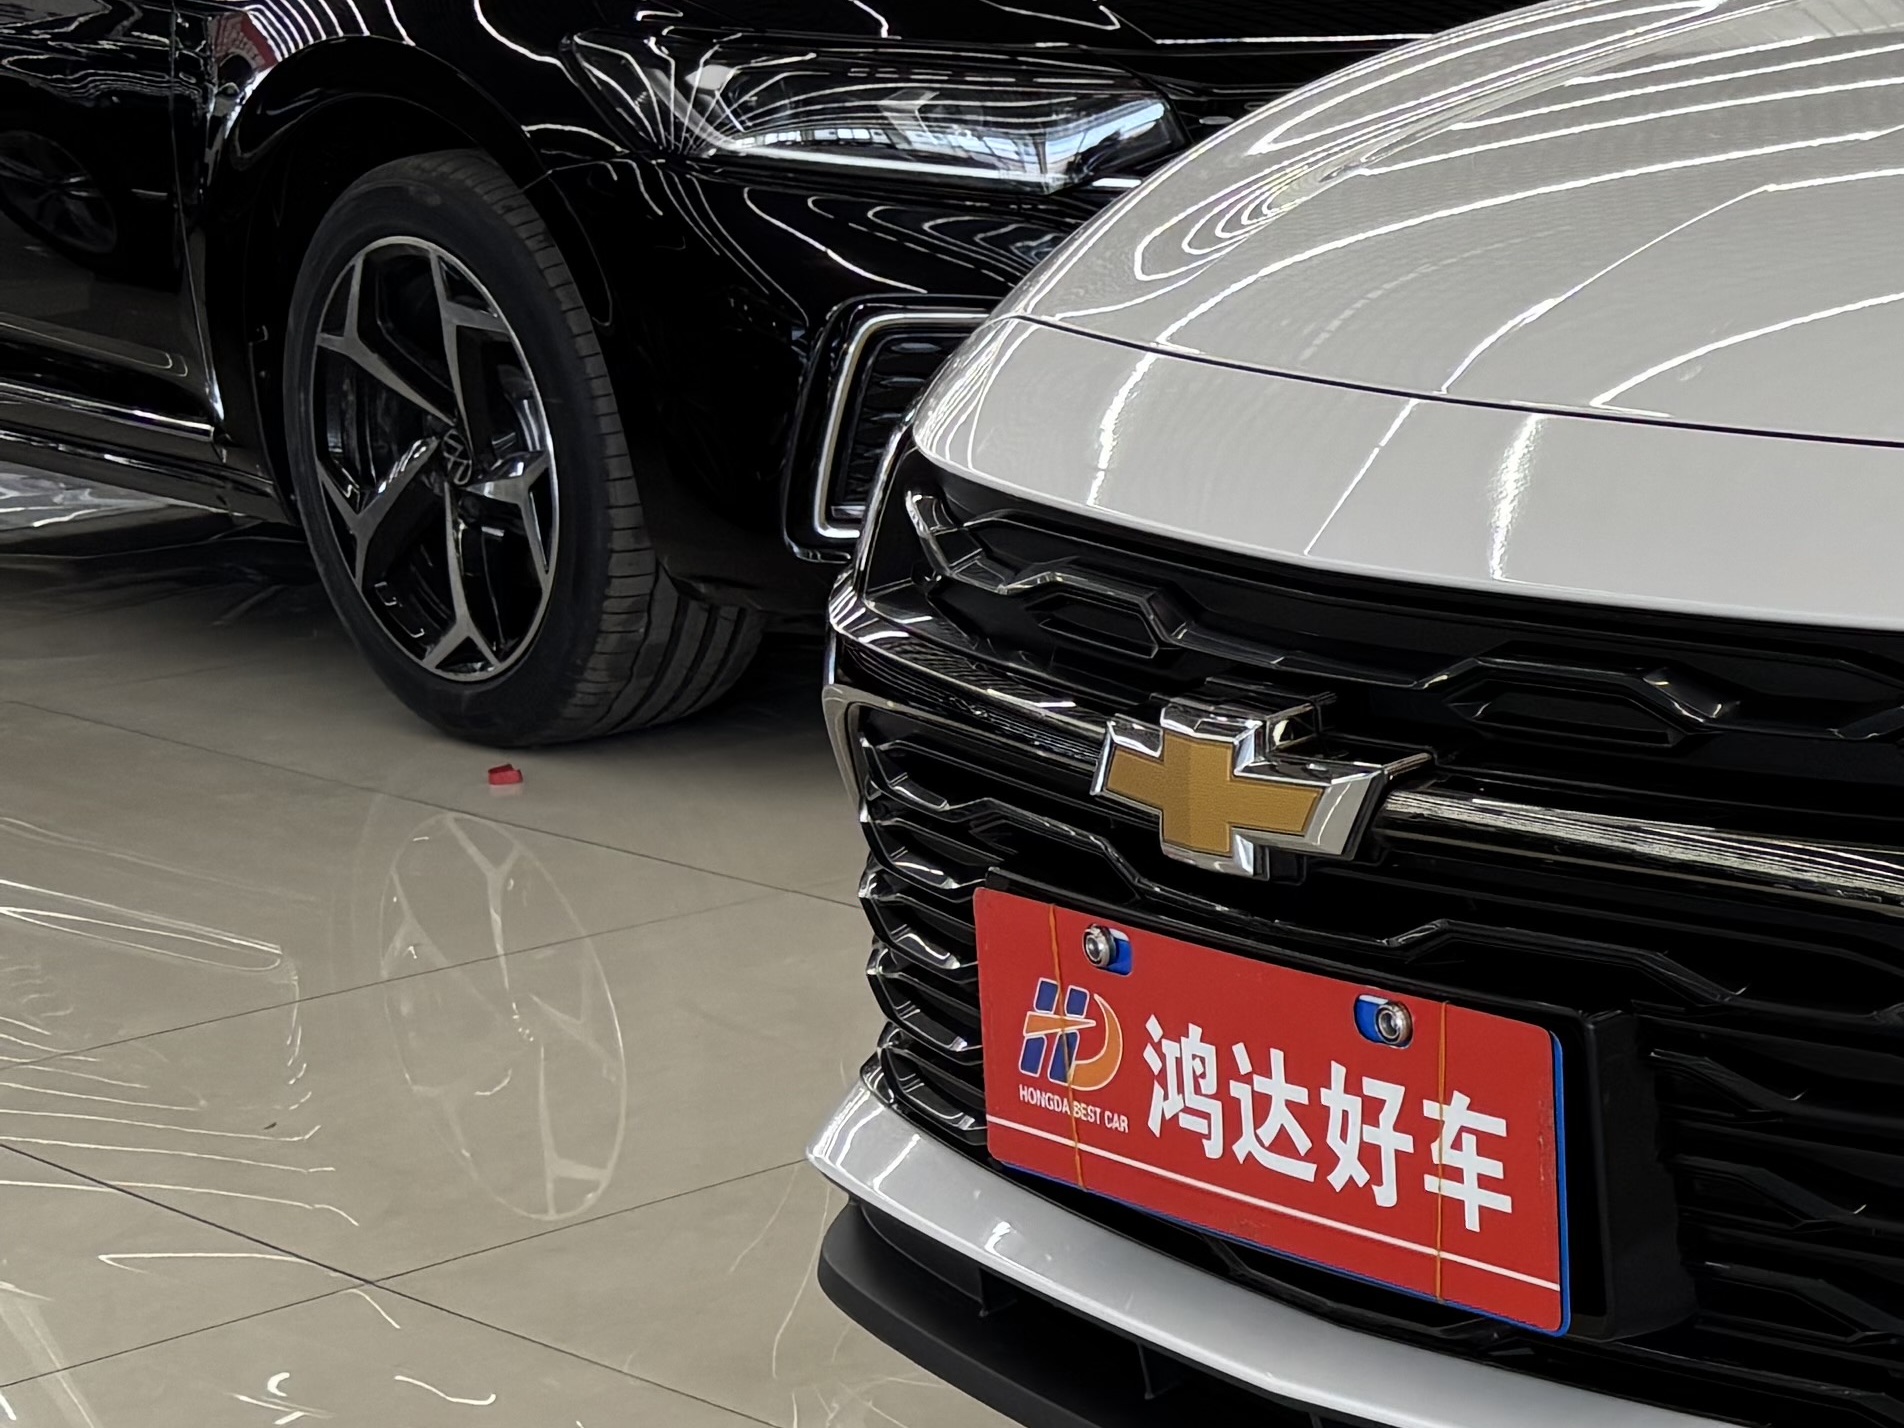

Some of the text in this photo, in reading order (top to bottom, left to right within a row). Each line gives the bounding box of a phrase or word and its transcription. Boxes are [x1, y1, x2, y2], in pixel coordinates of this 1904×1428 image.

[1018, 1083, 1128, 1133] HONGDA BEST CAR
[1142, 1014, 1513, 1233] 鸿达好车
